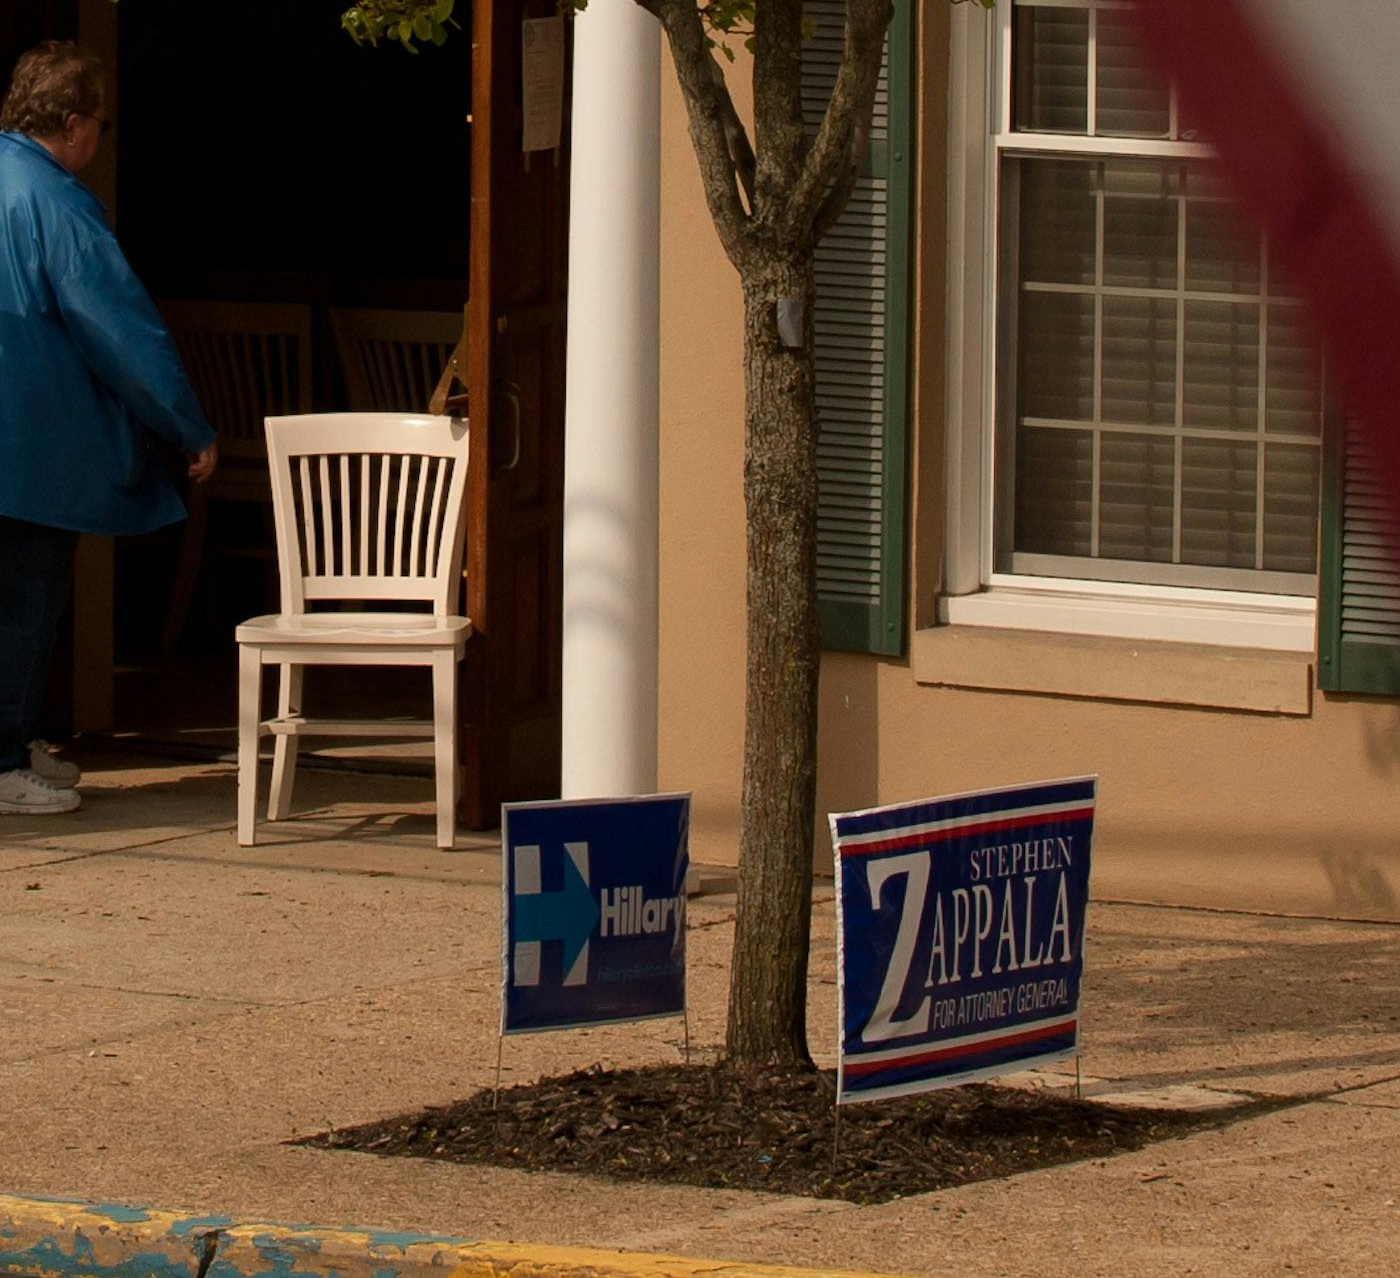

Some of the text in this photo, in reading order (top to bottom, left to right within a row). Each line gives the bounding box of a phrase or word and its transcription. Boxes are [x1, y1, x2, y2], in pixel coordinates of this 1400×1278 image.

[970, 836, 1073, 882] STEPHEN
[600, 885, 685, 957] Hillary
[861, 850, 1072, 1043] ZAPPALA
[933, 978, 1068, 1030] FOR ATTORNEY GENERAL
